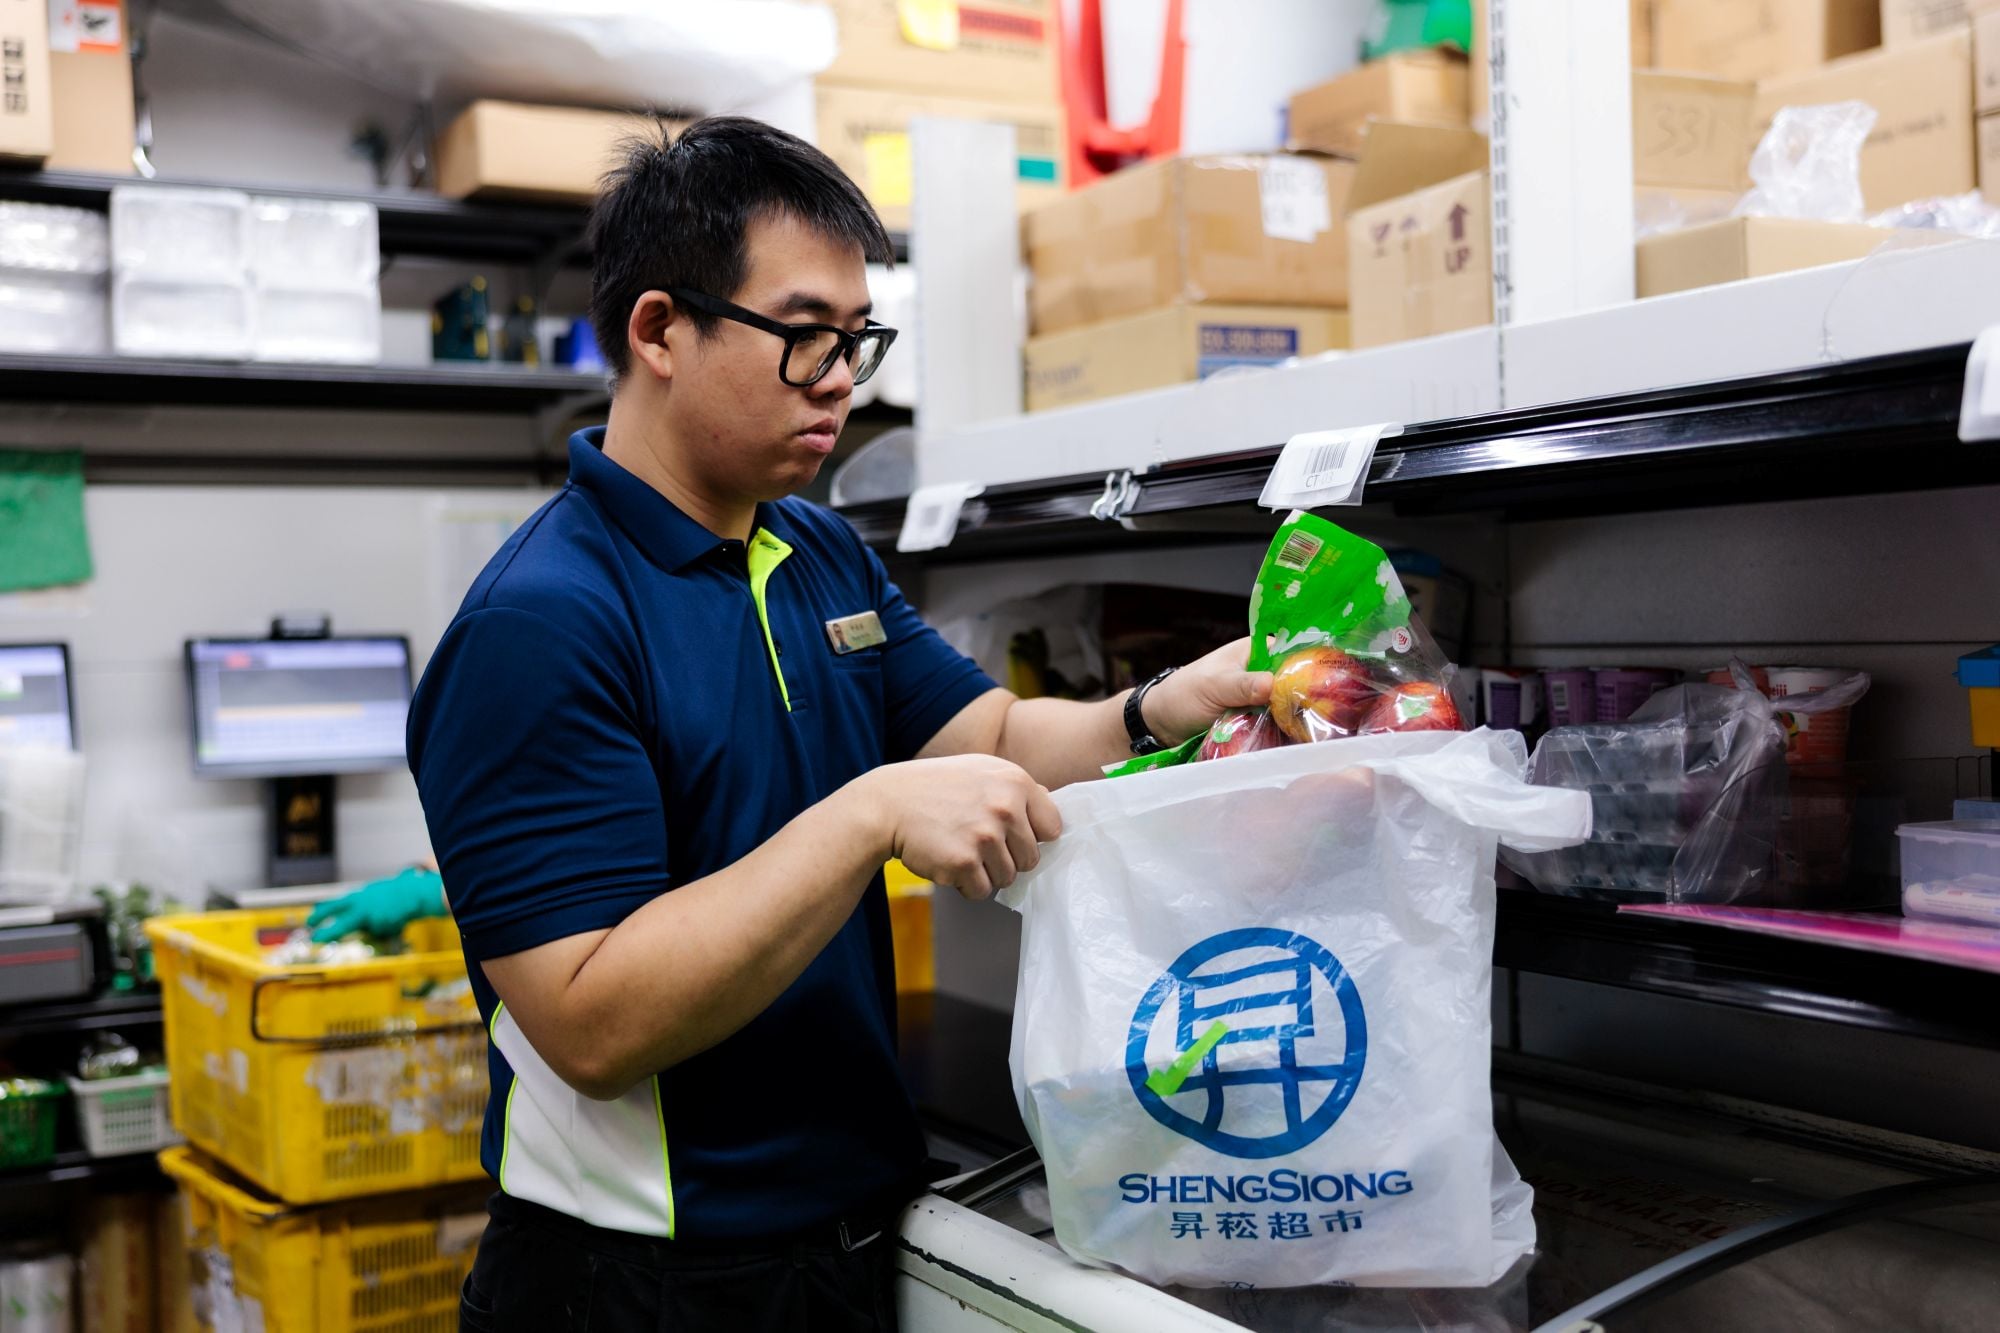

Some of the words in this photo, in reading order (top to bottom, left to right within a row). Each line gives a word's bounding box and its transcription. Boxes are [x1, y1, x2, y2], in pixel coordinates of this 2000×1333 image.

[1445, 246, 1472, 275] UP
[1169, 1210, 1364, 1240] 昇菘超市
